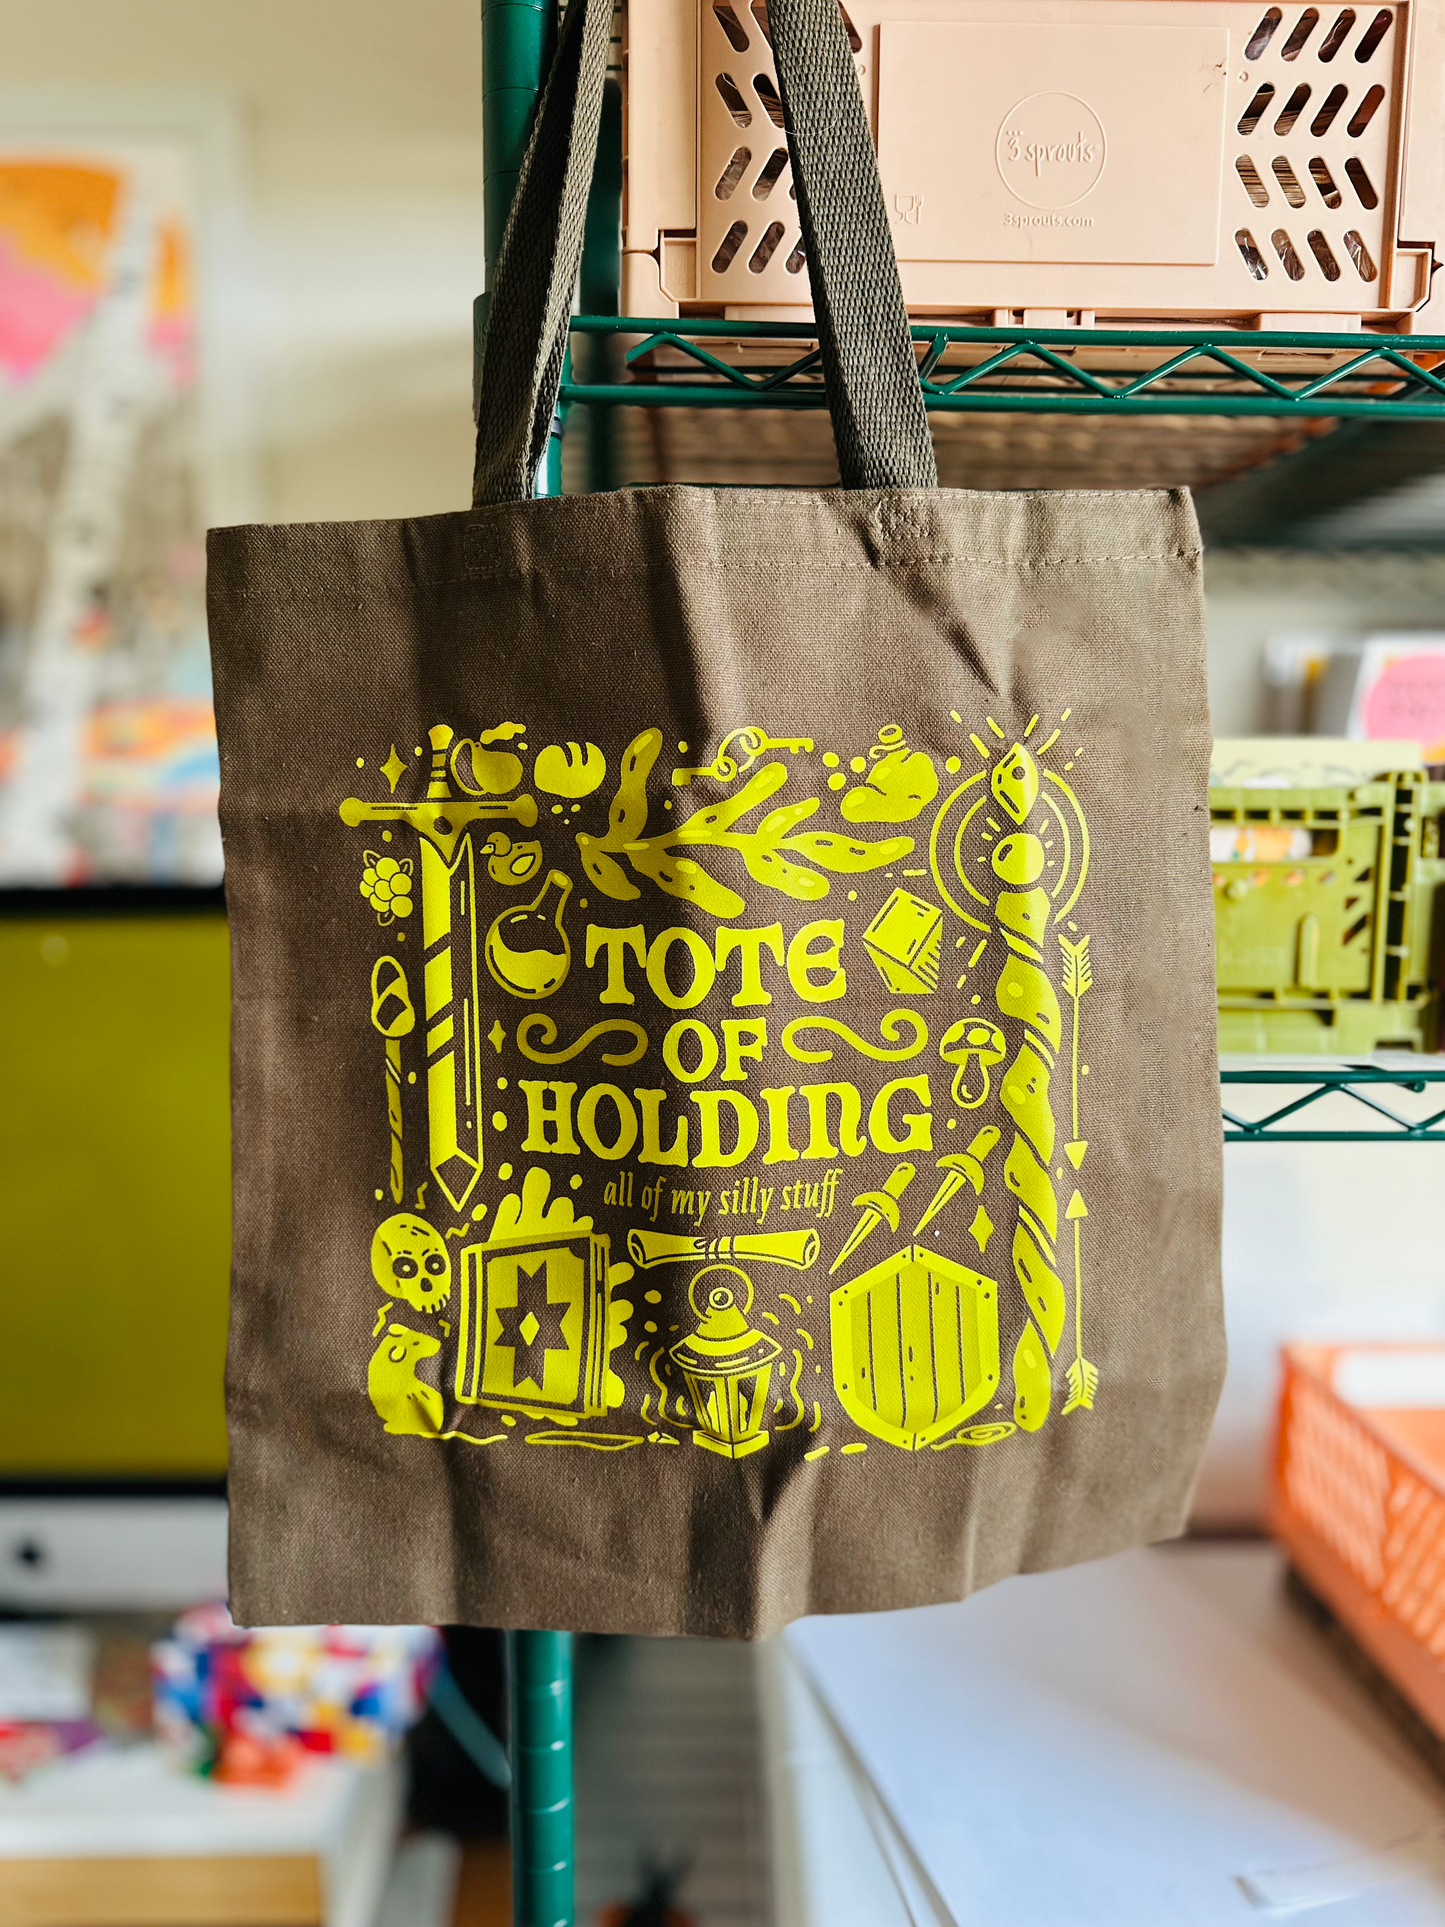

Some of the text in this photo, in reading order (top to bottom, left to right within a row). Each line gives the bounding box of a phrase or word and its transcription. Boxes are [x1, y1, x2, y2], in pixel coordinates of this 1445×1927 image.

[1025, 130, 1094, 177] sprouts
[1004, 212, 1094, 229] 3sprouts.com
[586, 918, 846, 1009] TOTE
[662, 1017, 768, 1083] OF
[518, 1074, 933, 1168] HOLDING
[603, 1168, 843, 1227] all of my silly stuff
